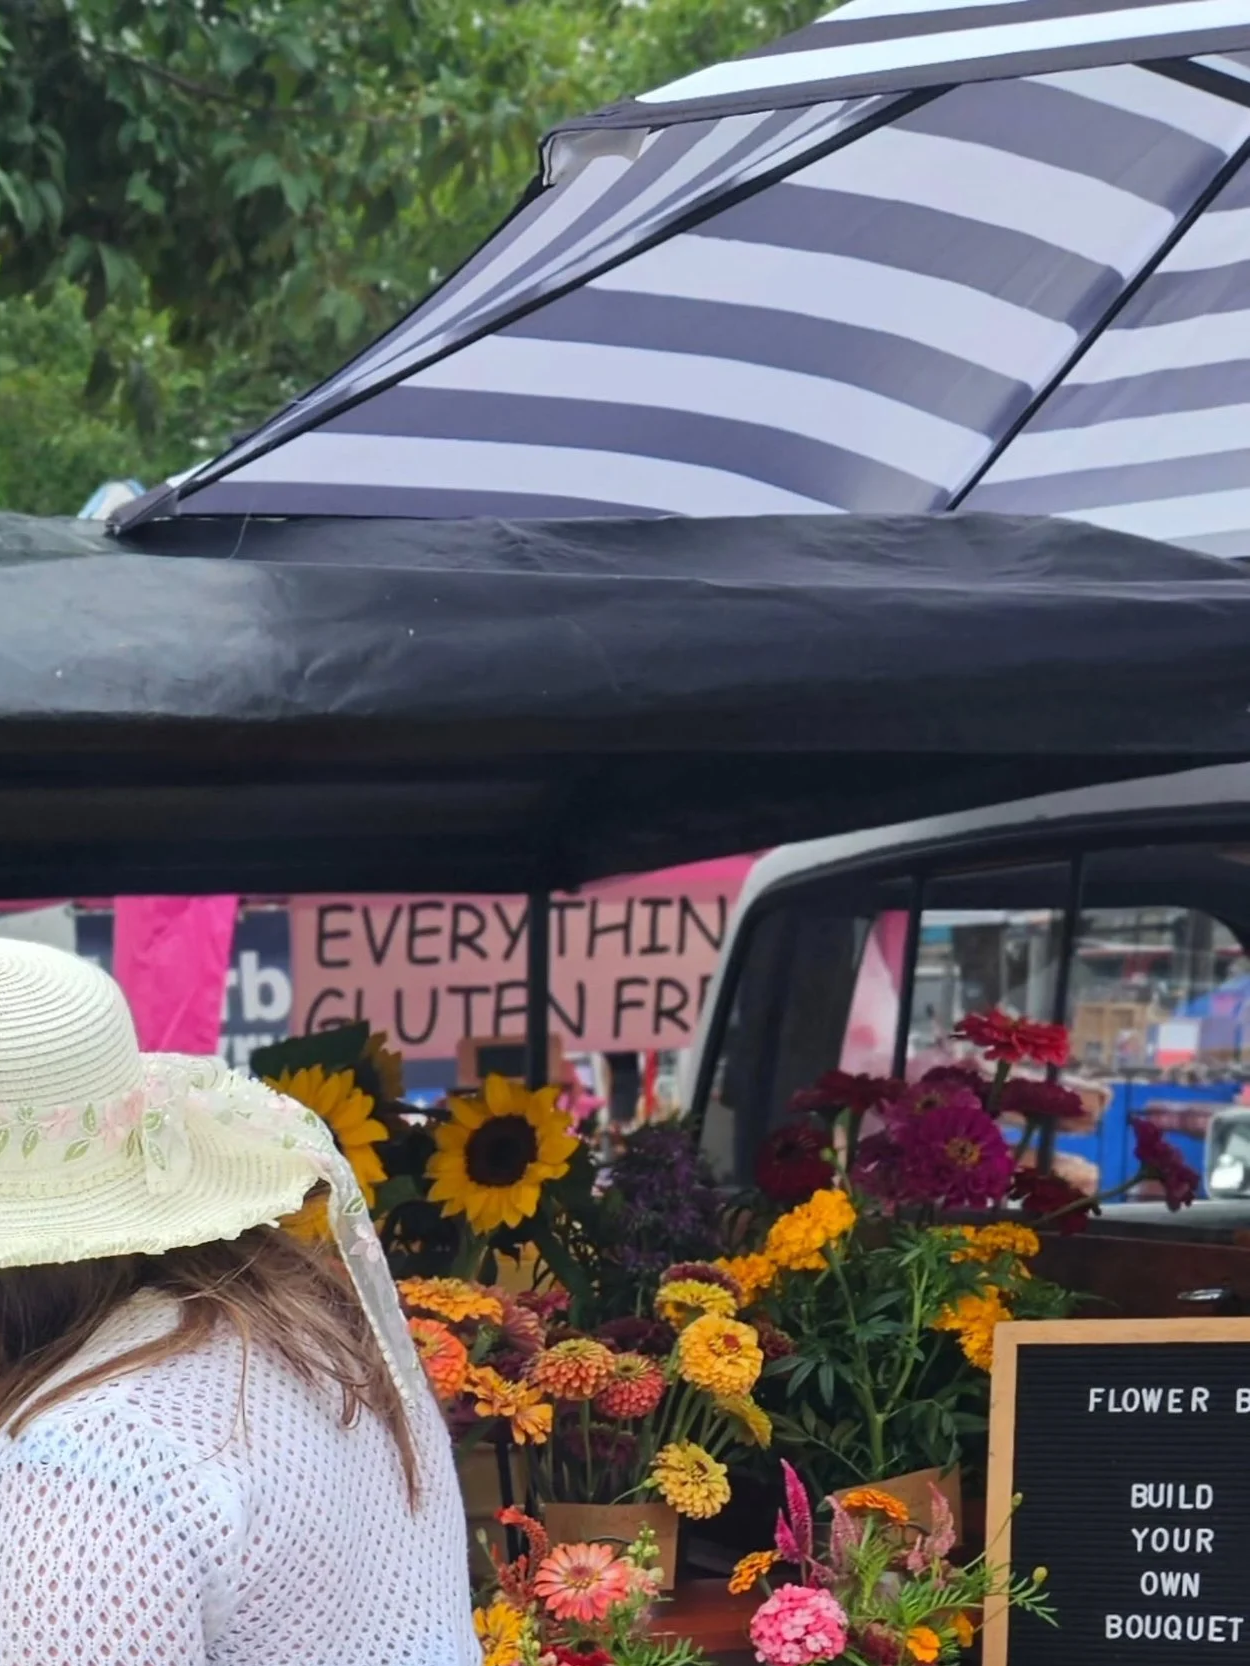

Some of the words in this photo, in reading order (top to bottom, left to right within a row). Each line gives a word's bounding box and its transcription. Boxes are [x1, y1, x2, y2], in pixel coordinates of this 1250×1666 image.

[1088, 1386, 1211, 1414] FLOWER
[1130, 1483, 1214, 1510] BUILD
[1130, 1527, 1215, 1553] YOUR
[1139, 1571, 1200, 1598] OWN
[1105, 1614, 1244, 1642] BOUQUET
